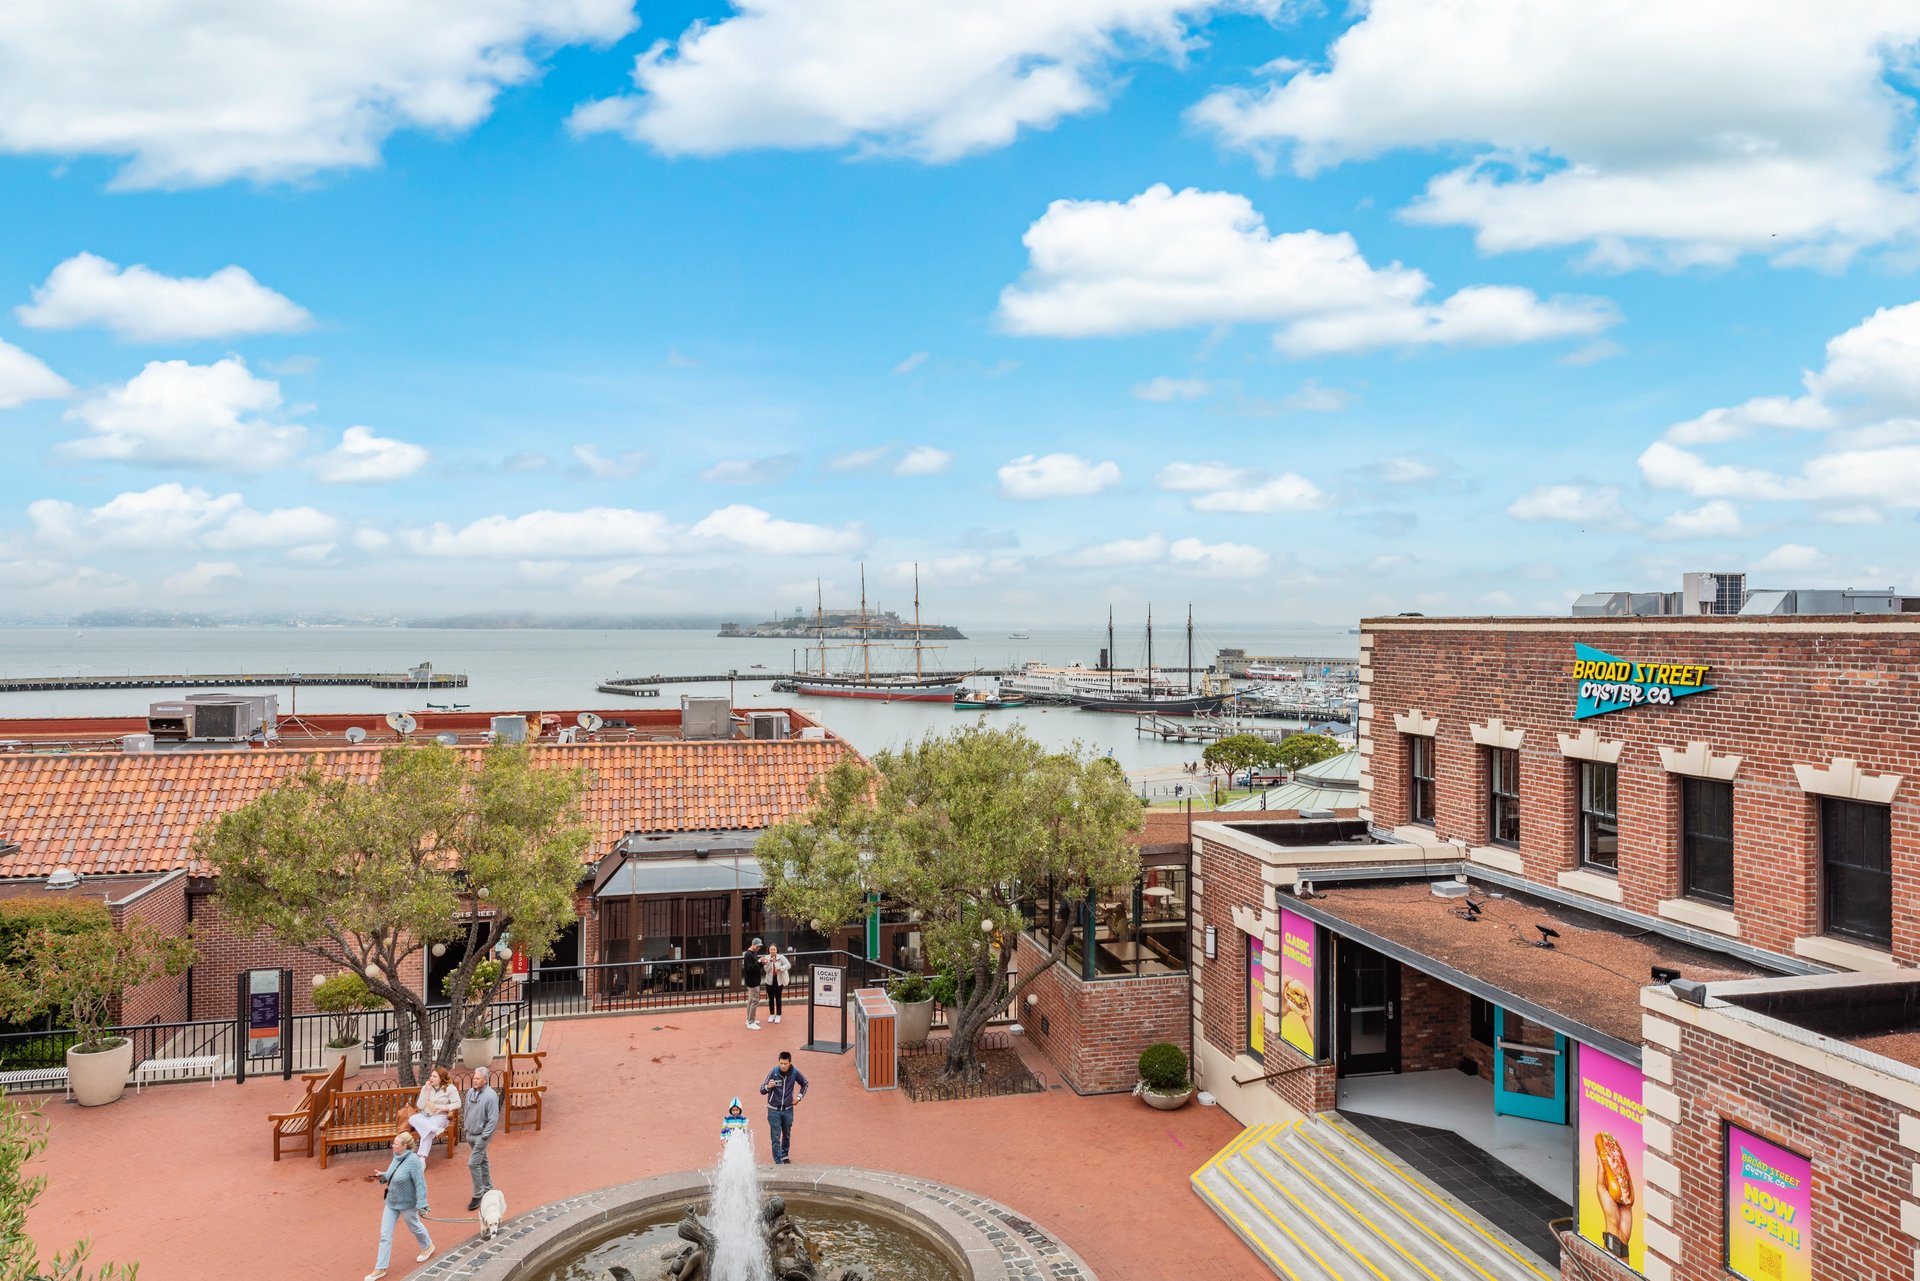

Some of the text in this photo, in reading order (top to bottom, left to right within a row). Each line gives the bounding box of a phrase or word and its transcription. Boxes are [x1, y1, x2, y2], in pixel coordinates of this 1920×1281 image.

[1573, 660, 1710, 687] BROAD STREET
[1581, 681, 1675, 708] OYSTER CO.
[1283, 944, 1312, 968] BURGERS
[1285, 932, 1310, 954] CLASSIC
[1583, 1077, 1612, 1098] WORLD
[1585, 1088, 1619, 1113] LOBSTER
[1742, 1153, 1800, 1187] BROAD STREET
[1745, 1164, 1774, 1183] OYSTER
[1744, 1182, 1796, 1224] NOW
[1741, 1203, 1800, 1250] OPEN!
